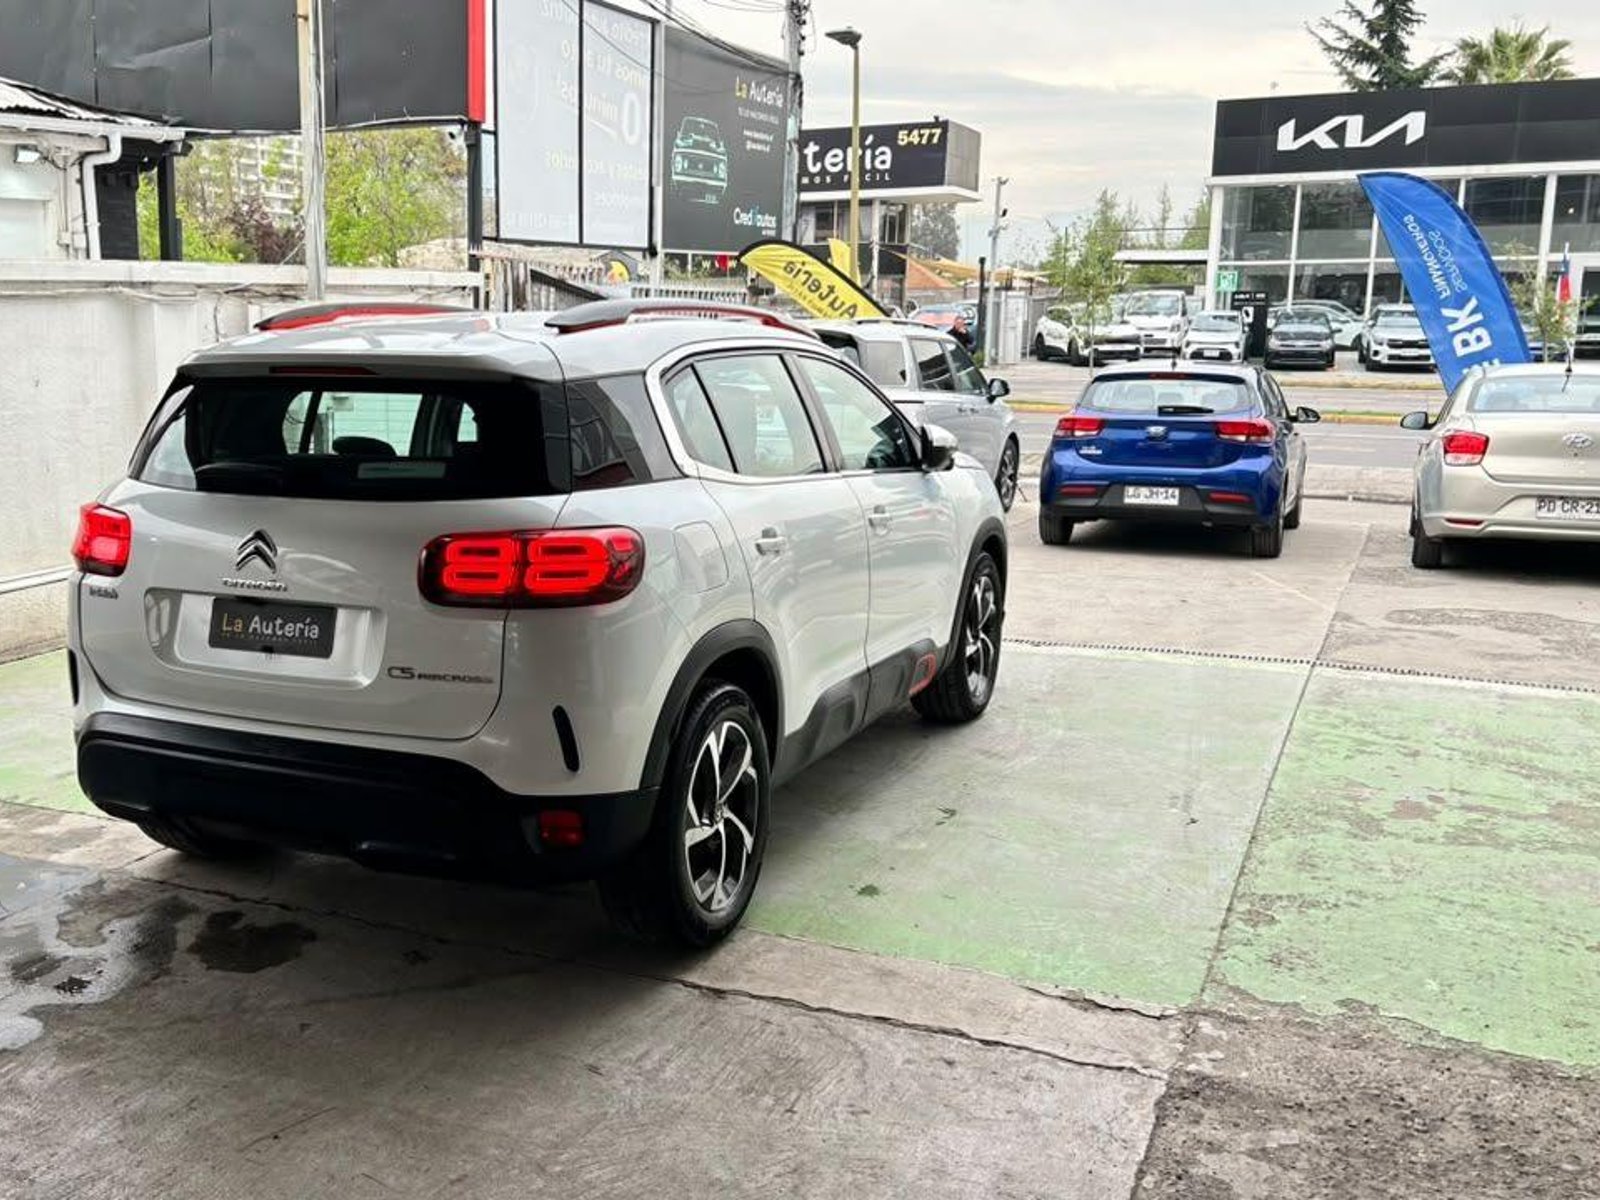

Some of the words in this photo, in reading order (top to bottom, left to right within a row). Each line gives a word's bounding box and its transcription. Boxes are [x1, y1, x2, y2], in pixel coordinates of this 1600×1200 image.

[897, 128, 942, 146] 5477
[1276, 111, 1427, 151] KIA
[803, 134, 893, 173] tería
[801, 175, 832, 185] MOS
[843, 172, 892, 182] FCIL
[222, 612, 244, 633] La
[248, 615, 320, 639] Autería
[387, 666, 416, 680] C5
